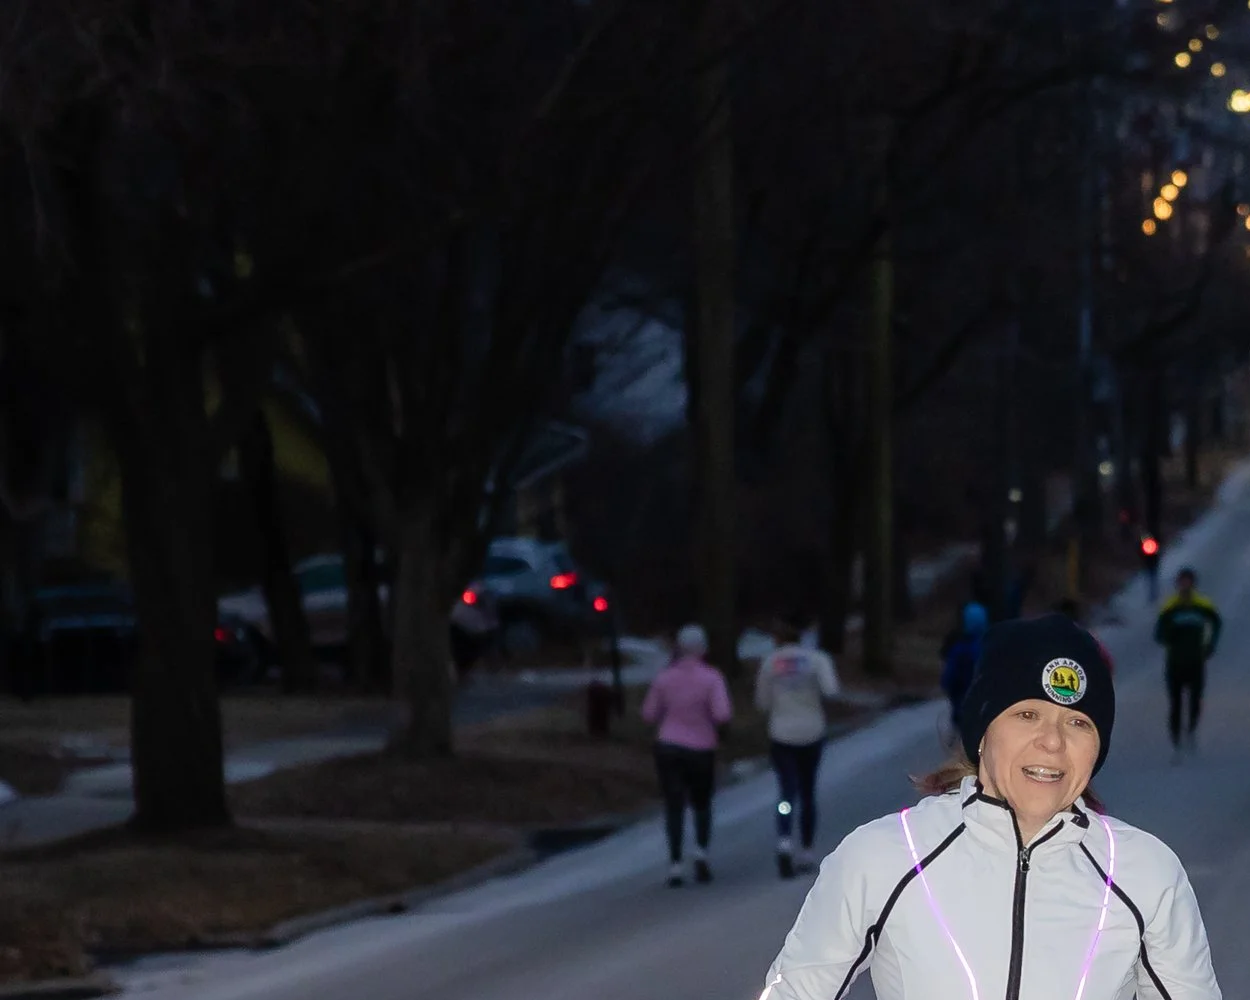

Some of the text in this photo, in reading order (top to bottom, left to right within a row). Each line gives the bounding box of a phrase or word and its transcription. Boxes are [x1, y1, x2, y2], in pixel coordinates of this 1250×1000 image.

[1046, 660, 1085, 681] ANN ARBOR
[1044, 683, 1072, 703] RUNNING
